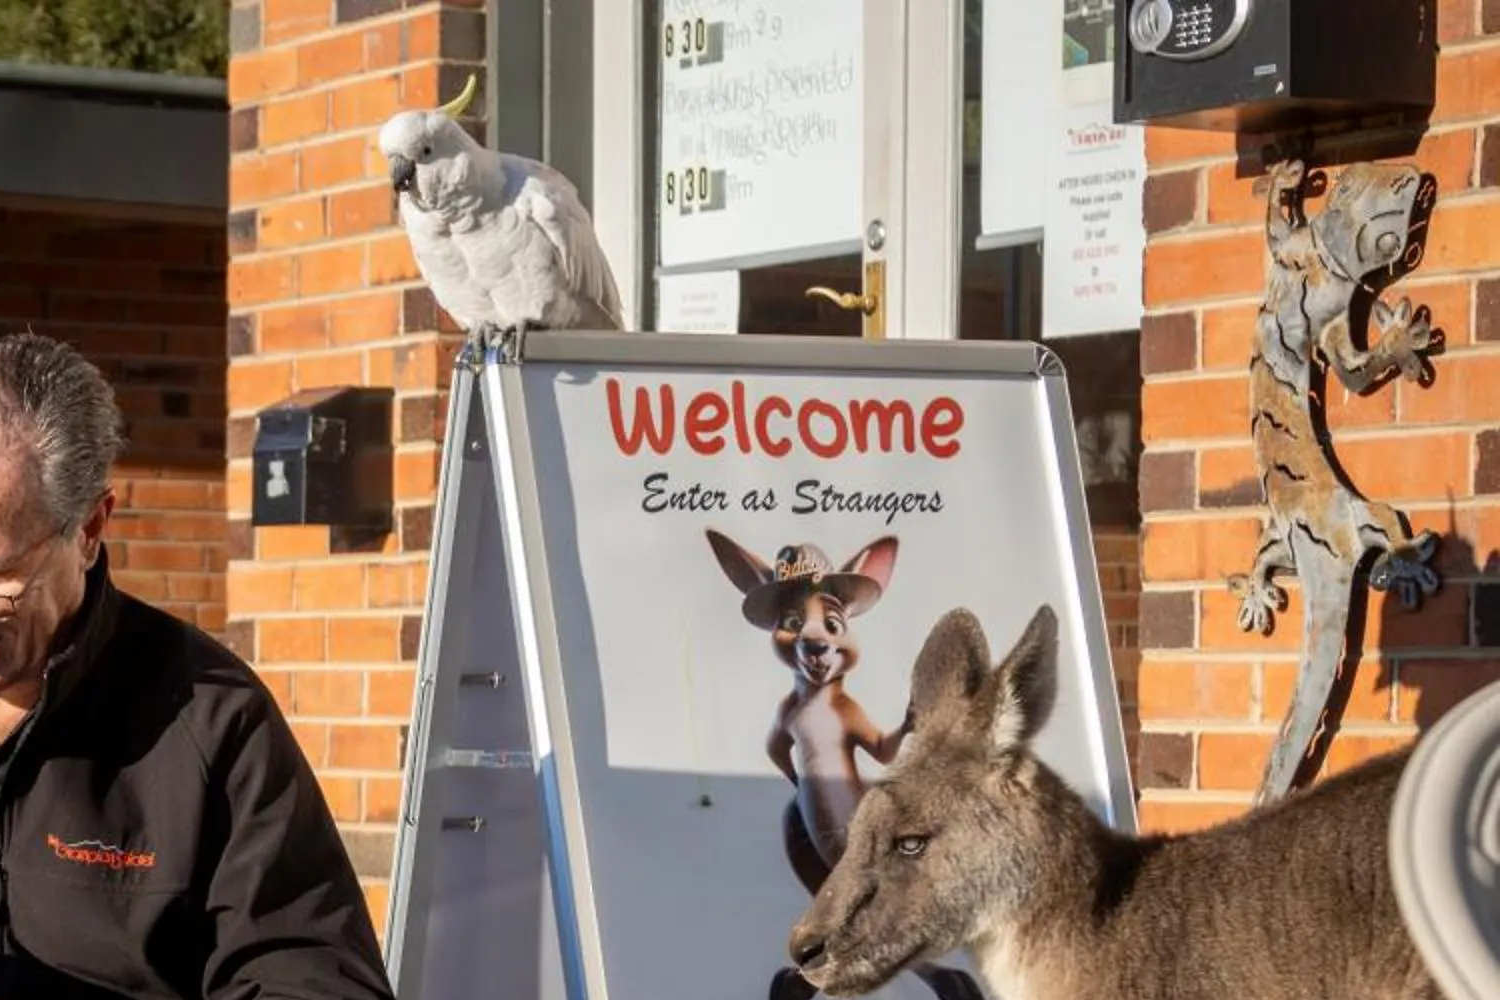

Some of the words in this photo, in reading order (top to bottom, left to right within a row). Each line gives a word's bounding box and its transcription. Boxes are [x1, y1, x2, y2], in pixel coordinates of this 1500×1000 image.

[606, 379, 964, 458] Welcome
[642, 473, 729, 513] Enter
[741, 488, 778, 512] as
[791, 480, 945, 525] Strangers
